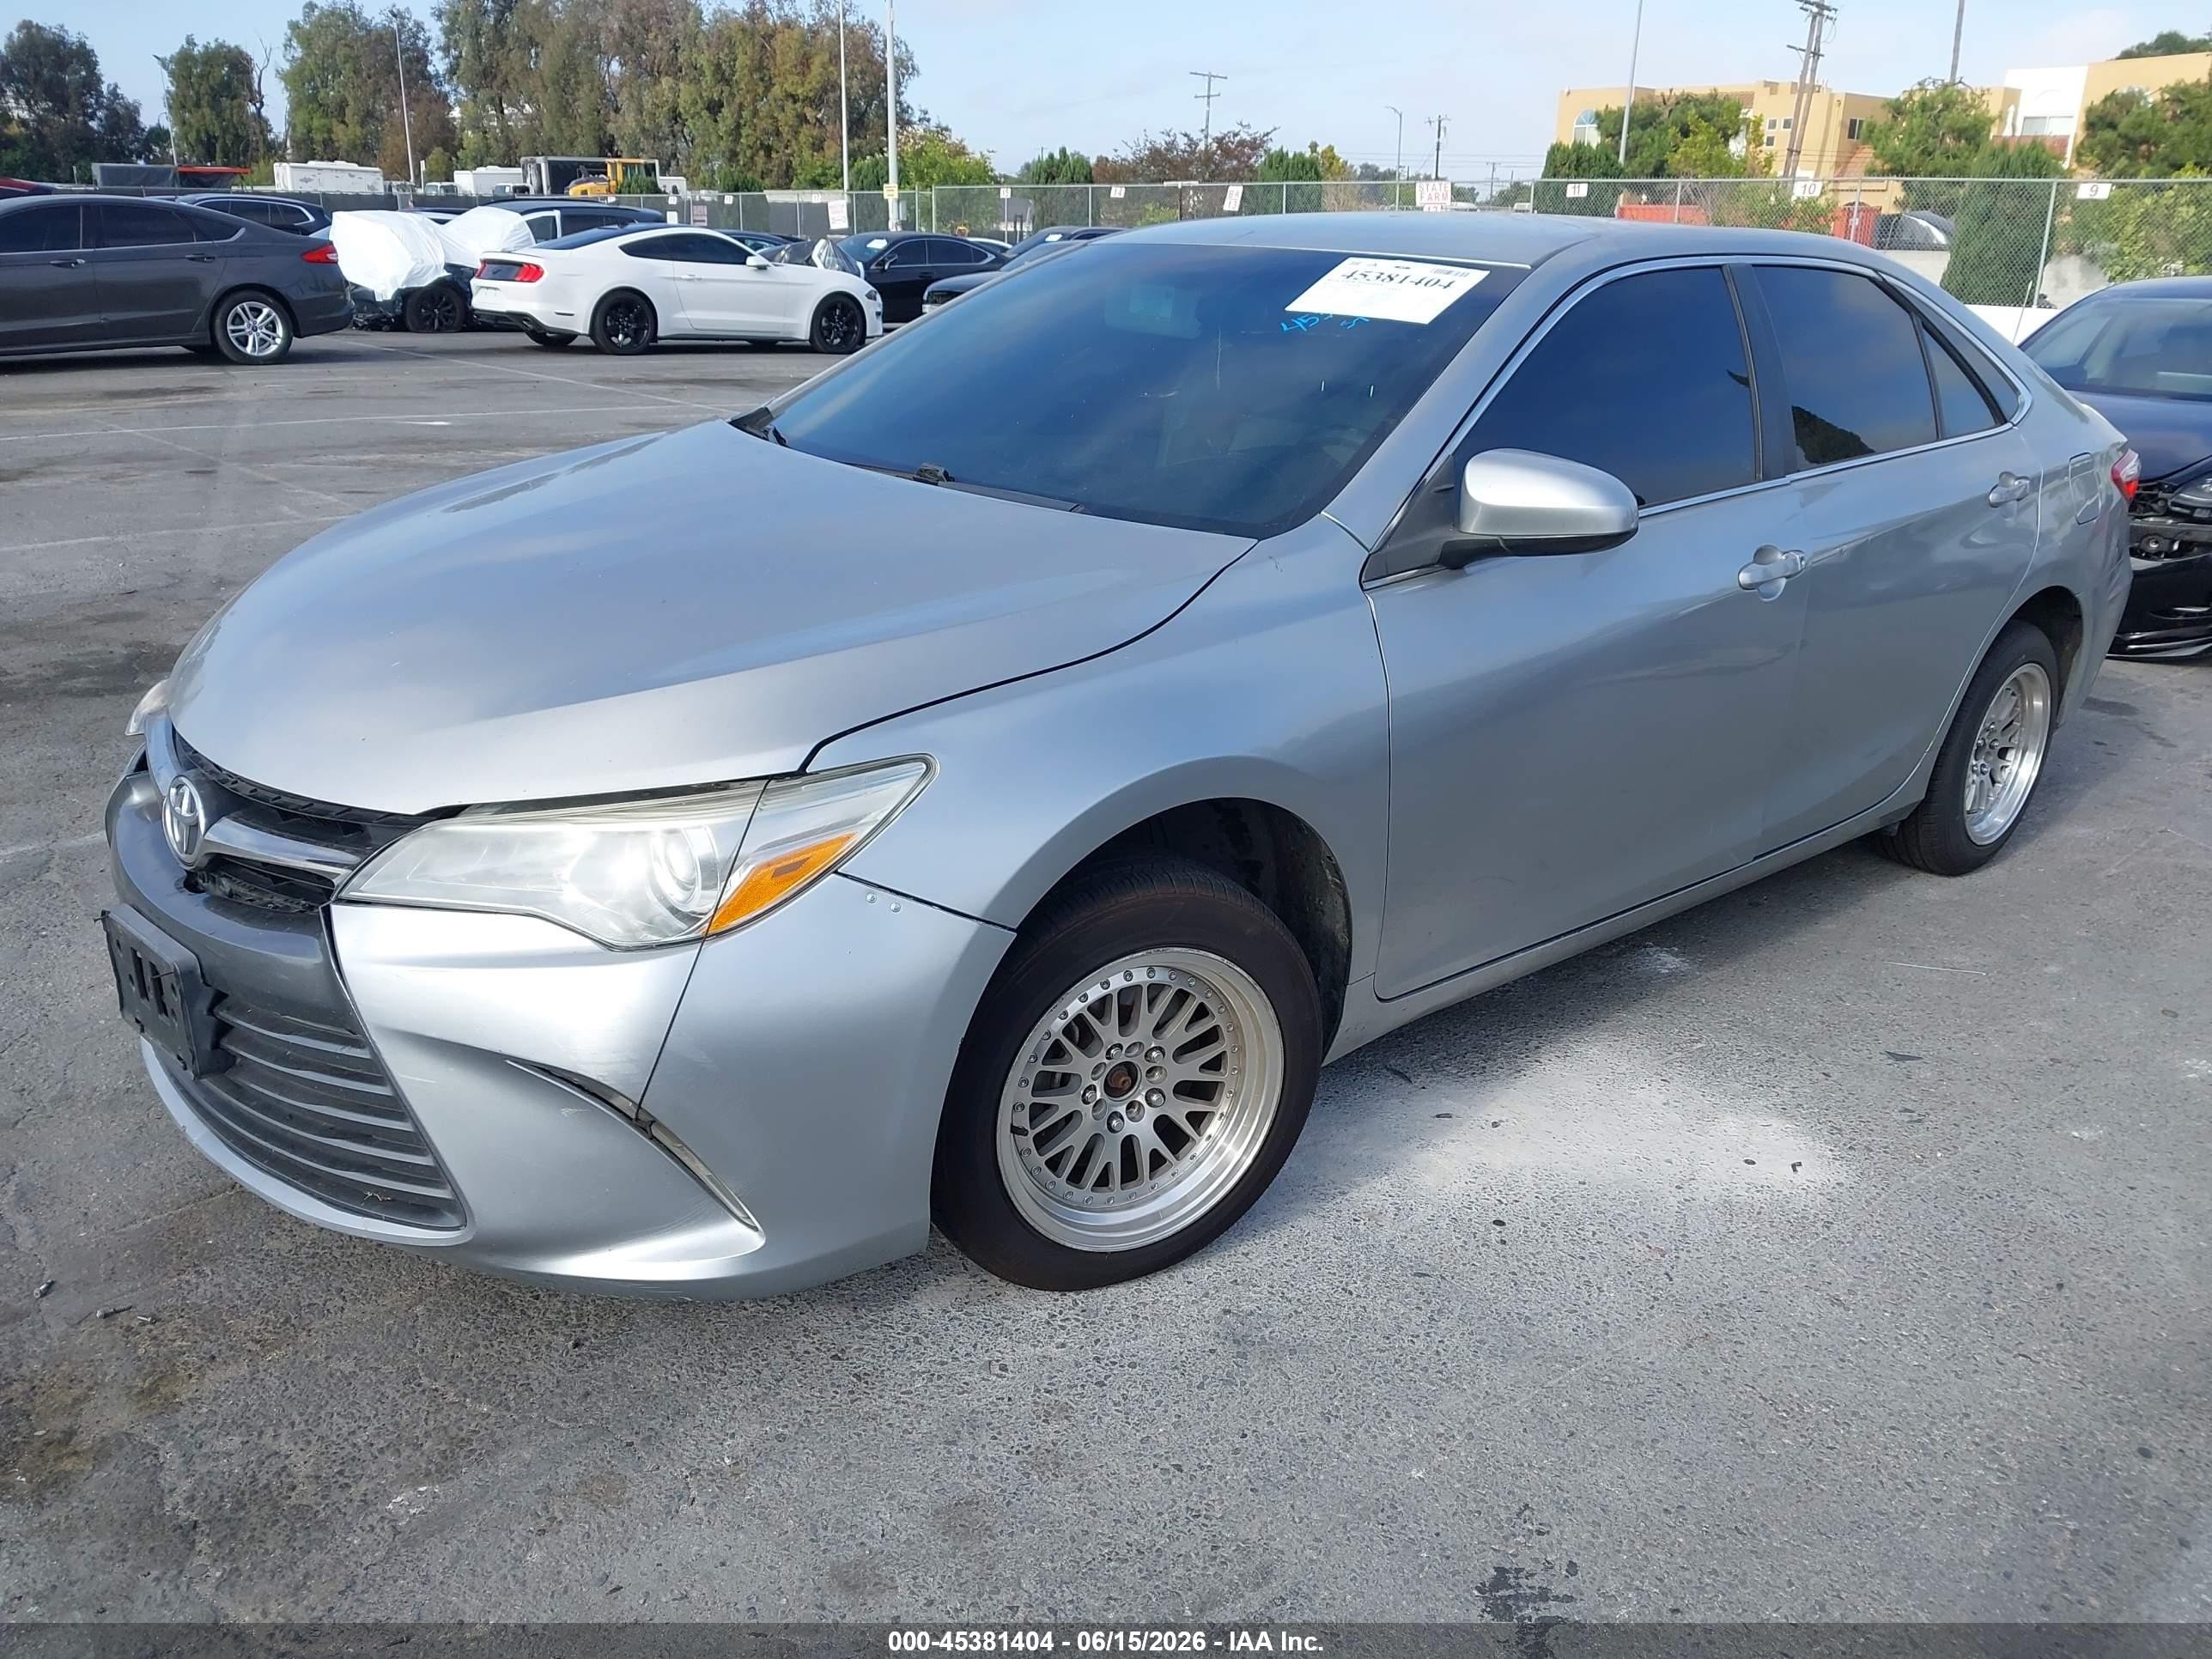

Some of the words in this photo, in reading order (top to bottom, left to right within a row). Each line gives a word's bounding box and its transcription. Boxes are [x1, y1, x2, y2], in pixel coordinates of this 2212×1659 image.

[1419, 182, 1449, 192] STATE
[1801, 183, 1816, 195] 10
[2089, 184, 2099, 197] 9
[1420, 191, 1449, 202] FARM
[1341, 270, 1455, 289] 45381404
